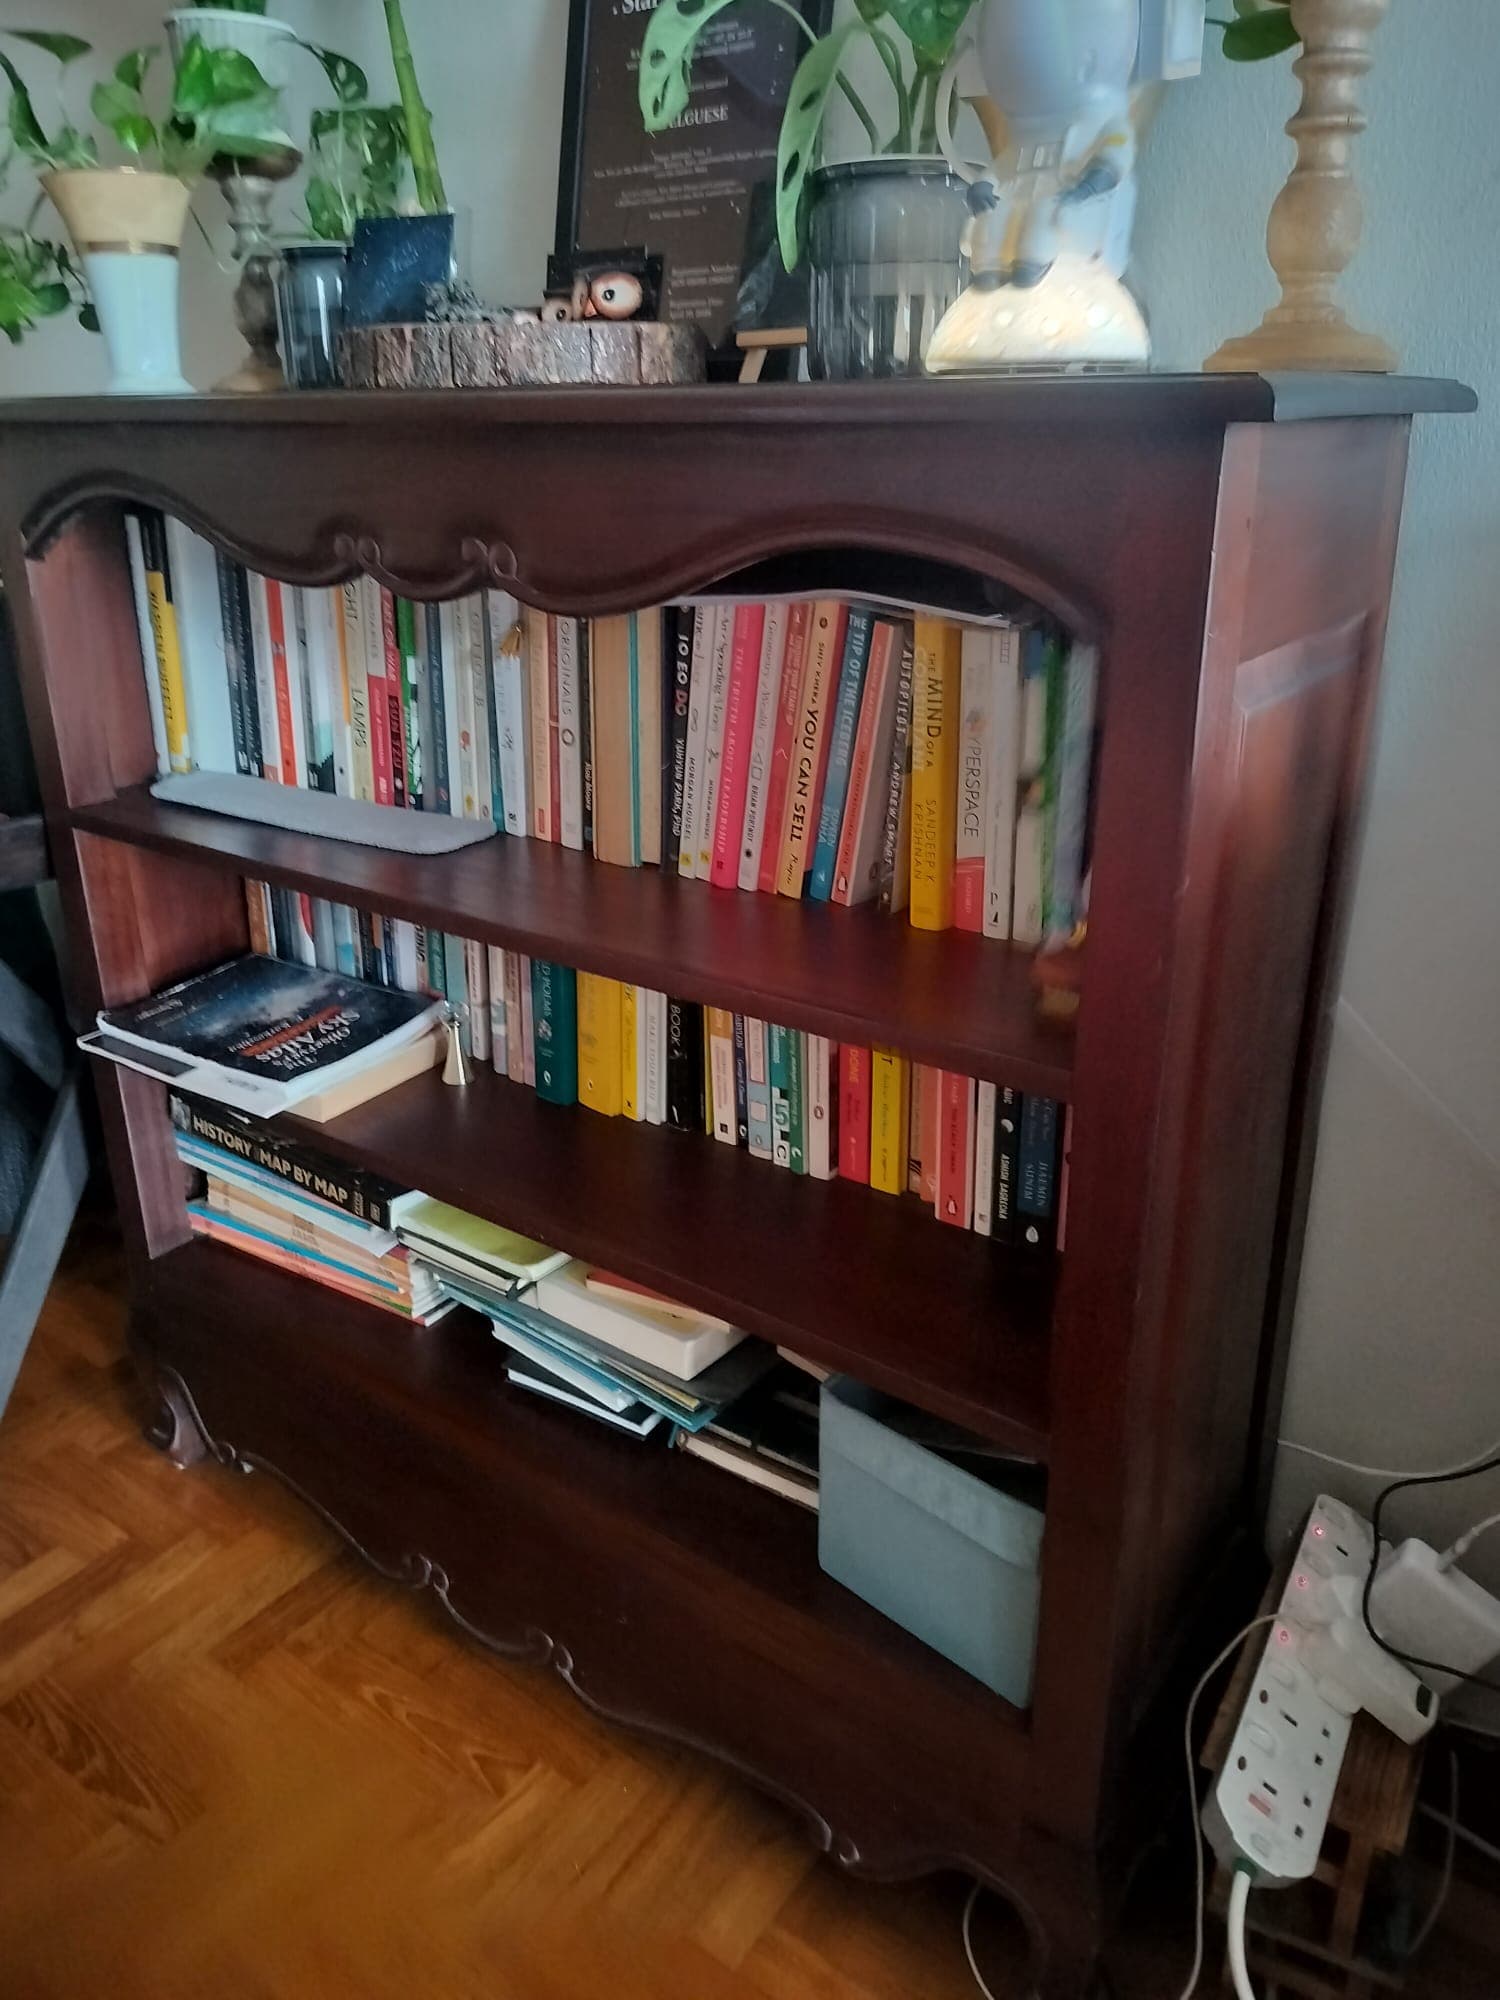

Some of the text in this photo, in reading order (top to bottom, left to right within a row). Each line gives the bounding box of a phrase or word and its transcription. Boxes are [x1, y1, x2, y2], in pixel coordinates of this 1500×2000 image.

[560, 620, 575, 717] ORIGINALS
[733, 647, 745, 673] THE
[927, 652, 937, 673] THE
[729, 680, 743, 724] TRUTH
[834, 614, 868, 767] THE TIP OF THE ICEBERG
[912, 646, 928, 772] CONSULTANT
[926, 676, 943, 738] MIND
[352, 688, 367, 749] LAMPS
[724, 729, 737, 773] ABOUT
[884, 649, 913, 866] AUTOPILOT ANDREW SMART
[926, 741, 935, 756] OF
[685, 757, 697, 799] MORGAN
[749, 784, 760, 808] BRIAN
[789, 706, 820, 843] YOU CAN SELL
[963, 735, 982, 838] YPERSPACE
[716, 777, 733, 854] LEADERSHIP
[925, 799, 938, 869] SANDEEP
[914, 801, 925, 880] KRISHNAN
[542, 977, 553, 1018] POEMS
[254, 1007, 361, 1063] Sky Atlas
[648, 1015, 657, 1044] MAKE
[671, 1004, 682, 1047] BOOK
[648, 1047, 657, 1076] YOUR
[848, 1048, 859, 1083] DONE
[193, 1114, 348, 1205] HISTORY MAP BY MAP
[1000, 1153, 1010, 1180] ASHISH
[1036, 1160, 1049, 1209] HAEMIN
